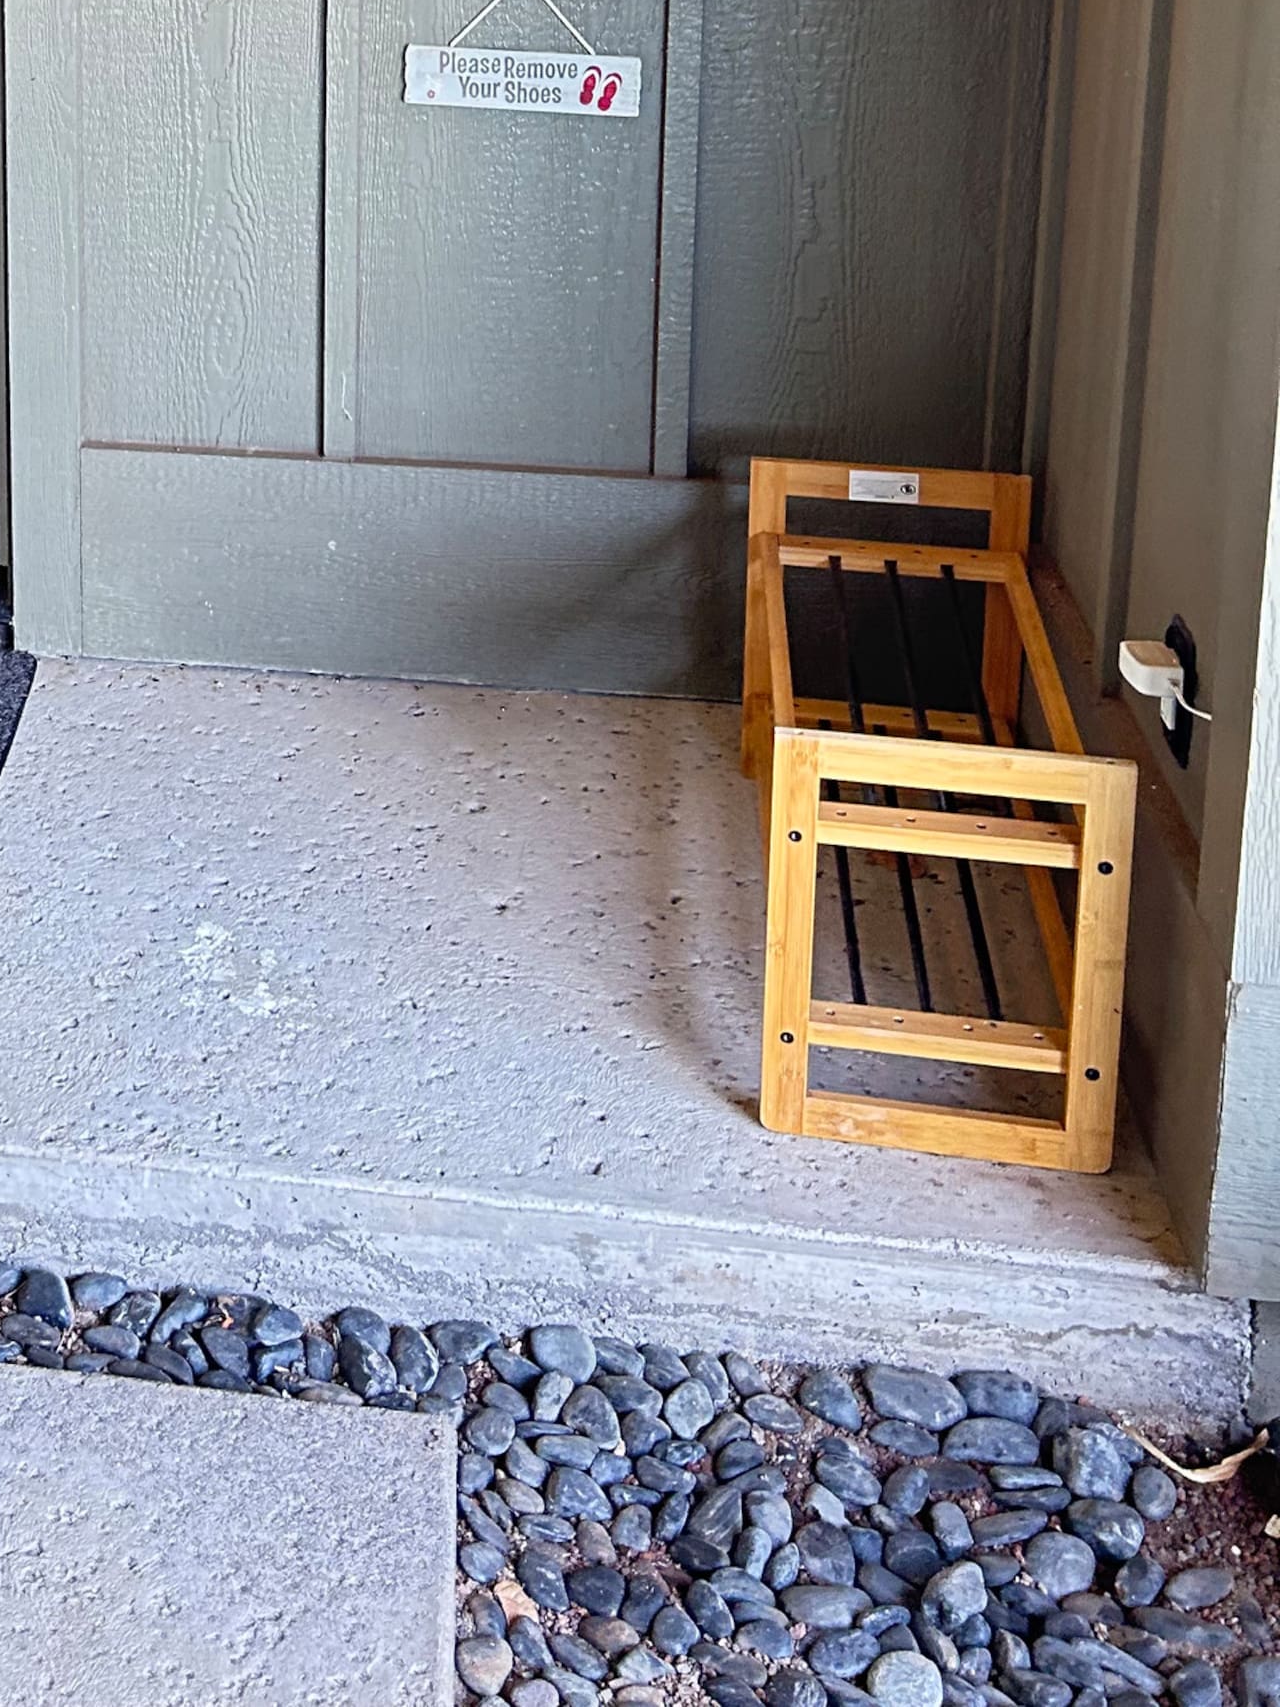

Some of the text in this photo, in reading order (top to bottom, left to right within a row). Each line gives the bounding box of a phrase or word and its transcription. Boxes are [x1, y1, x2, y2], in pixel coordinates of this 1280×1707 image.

[439, 50, 578, 79] Please Remove
[458, 75, 562, 104] Your Shoes
